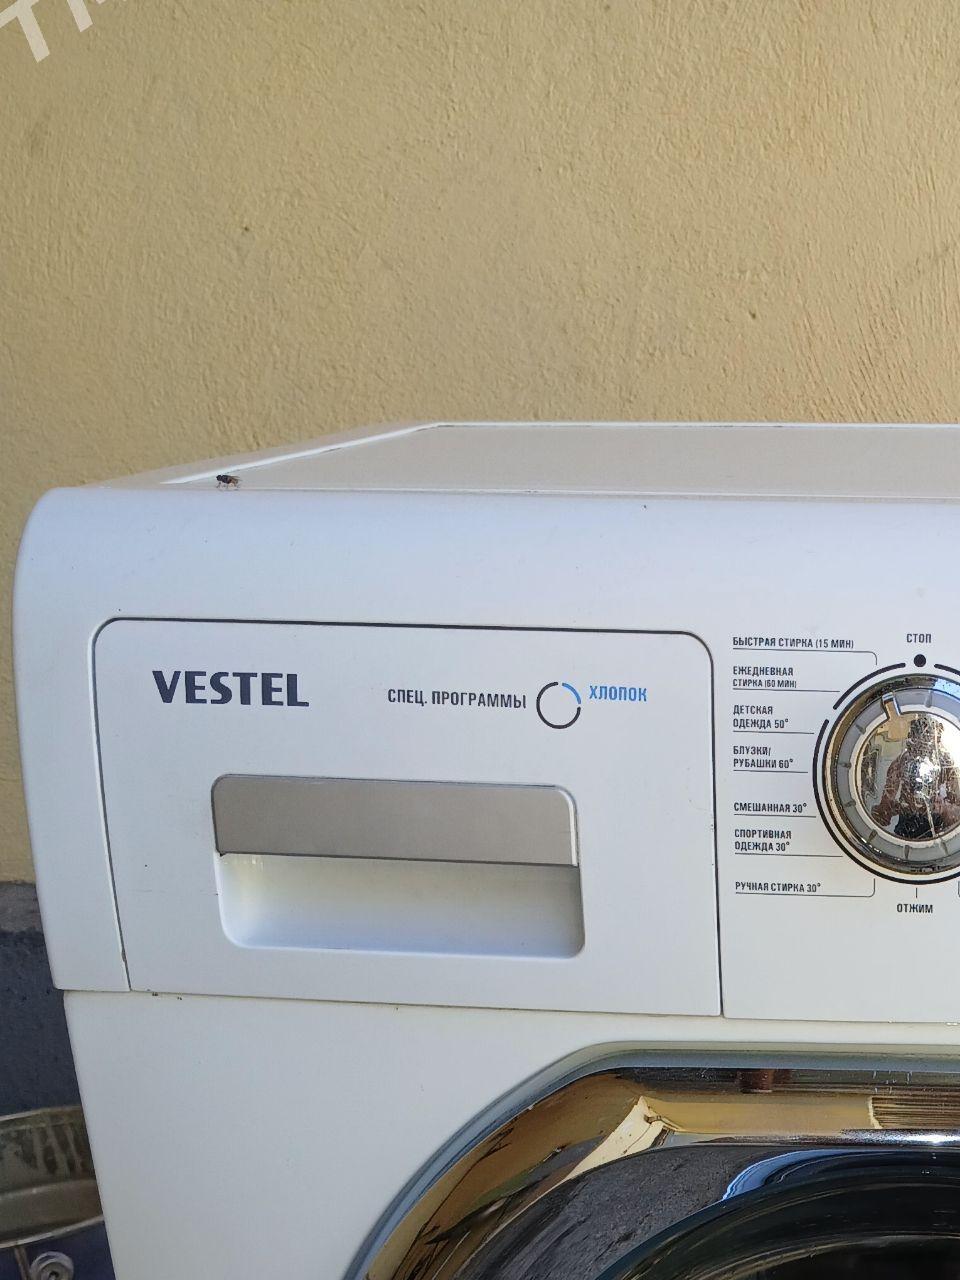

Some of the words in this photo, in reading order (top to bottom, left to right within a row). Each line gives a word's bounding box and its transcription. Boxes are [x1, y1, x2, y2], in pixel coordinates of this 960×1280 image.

[732, 636, 776, 648] БЫСТРАЯ
[779, 637, 814, 648] СТИРКА
[815, 638, 829, 649] (15
[831, 638, 854, 649] МИН)
[906, 633, 932, 644] СТОП
[732, 666, 794, 677] ЕЖЕДНЕВНАЯ
[152, 670, 310, 708] VESTEL
[732, 678, 763, 688] СТИРКА
[777, 680, 797, 689] МИН)
[387, 688, 428, 706] СПЕЦ.
[431, 690, 527, 709] ПРОГРАММЫ
[588, 685, 648, 702] ХЛОПОК
[732, 705, 773, 716] ДЕТСКАЯ
[732, 718, 773, 729] ОДЕЖДА
[733, 746, 771, 757] БЛУЗКИ/
[733, 758, 778, 769] РУБАШКИ
[733, 802, 791, 813] СМЕШАННАЯ
[734, 829, 792, 840] СПОРТИВНАЯ
[734, 841, 774, 852] ОДЕЖДА
[735, 882, 769, 892] РУЧНАЯ
[770, 883, 805, 893] СТИРКА
[896, 903, 934, 914] ОТЖИМ
